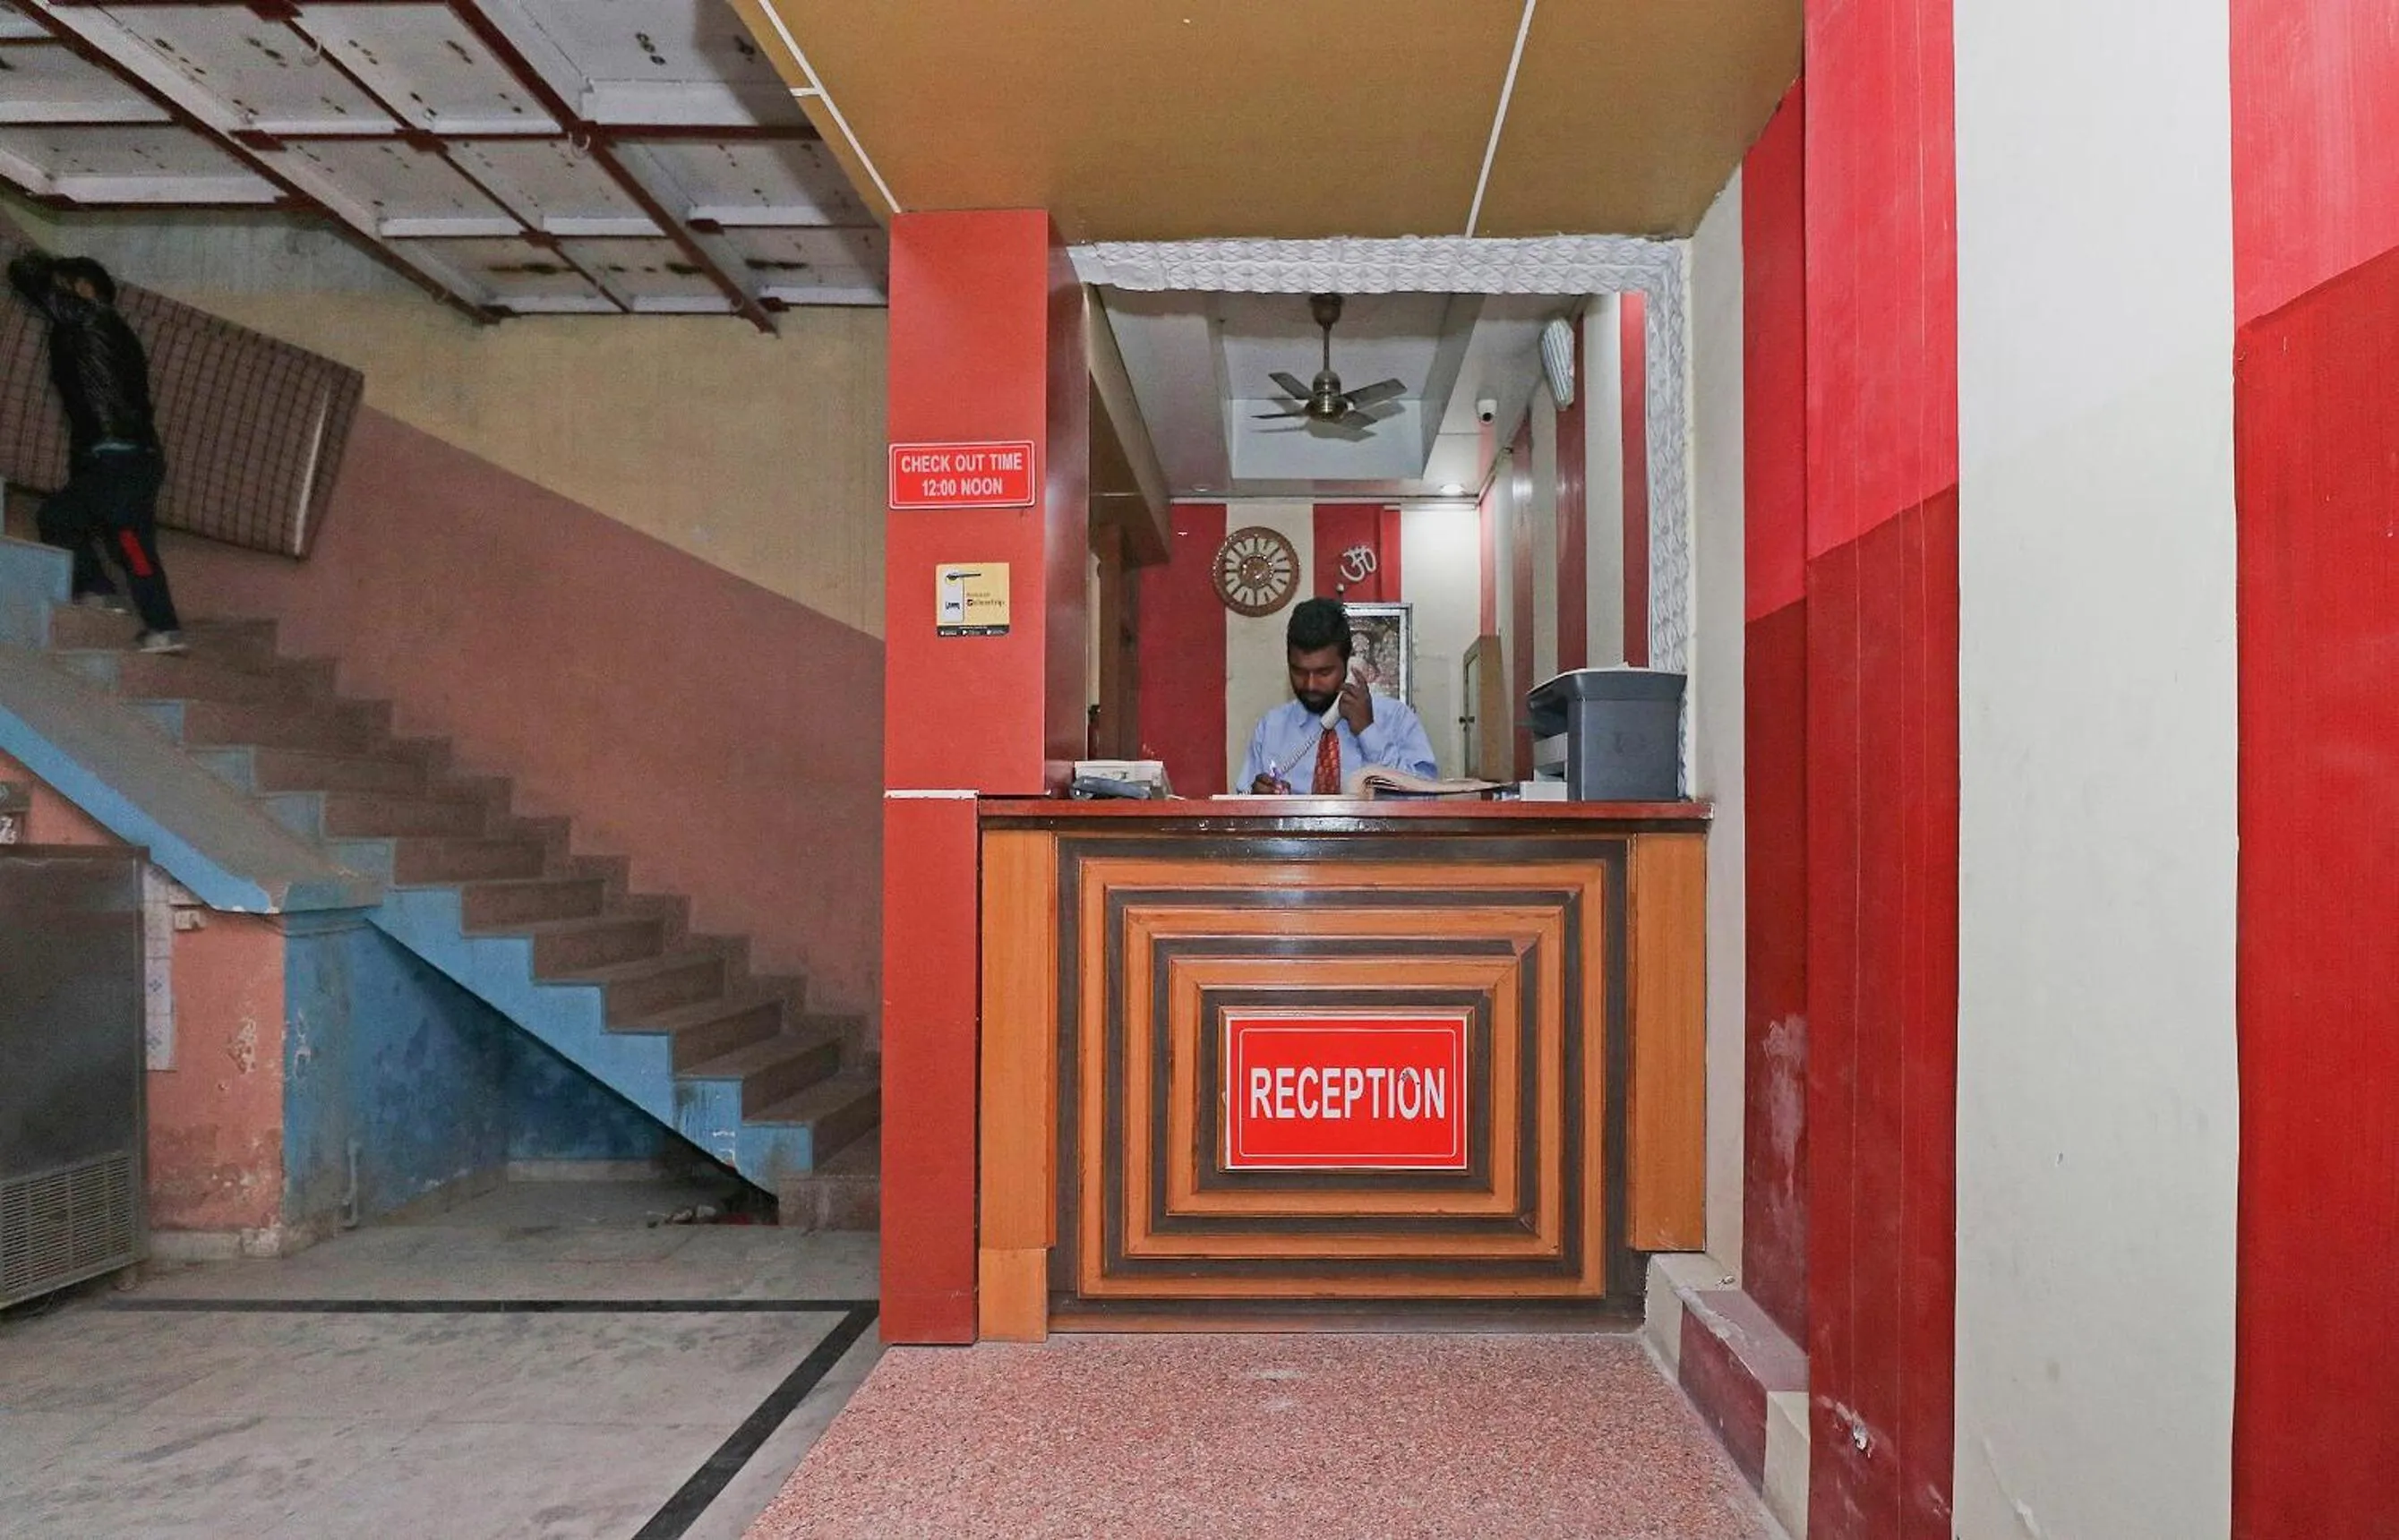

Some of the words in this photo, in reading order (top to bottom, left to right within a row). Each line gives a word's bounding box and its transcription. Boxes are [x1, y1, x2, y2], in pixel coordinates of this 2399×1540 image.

[901, 455, 951, 473] CHECK
[955, 454, 984, 472] OUT
[990, 452, 1023, 471] TIME
[921, 479, 956, 496] 12:00
[961, 477, 1003, 495] NOON
[1250, 1066, 1445, 1119] RECEPTION
